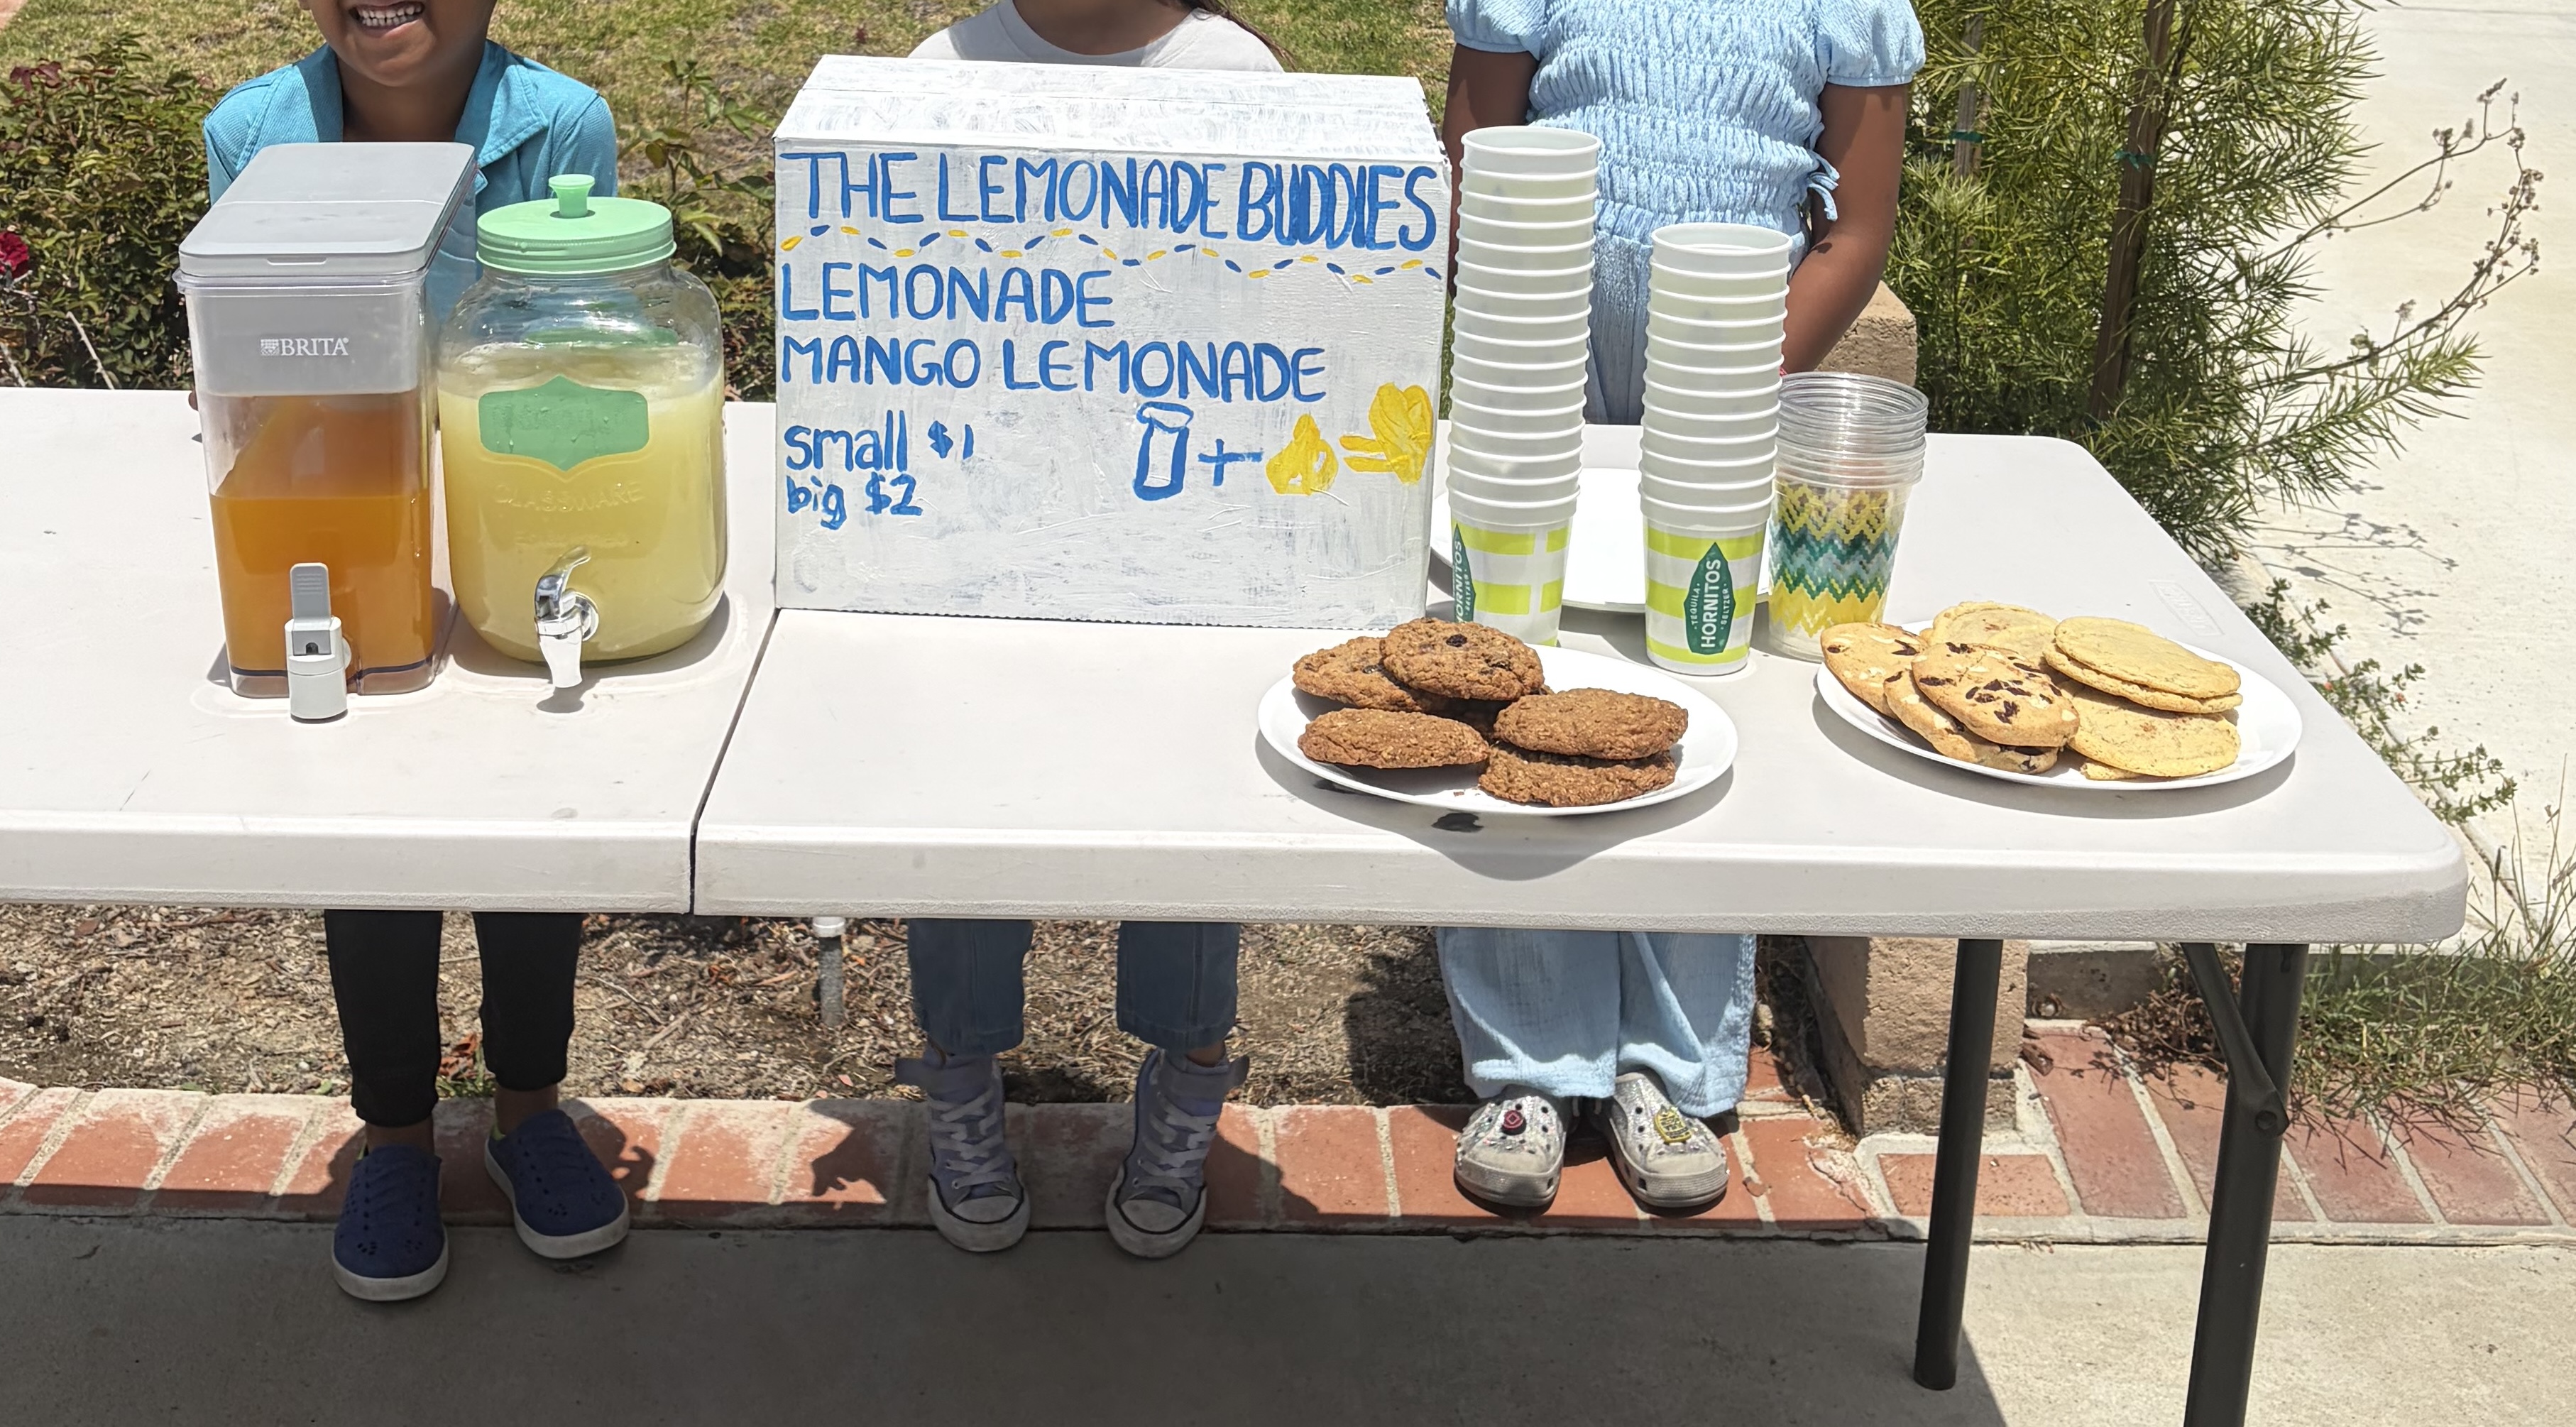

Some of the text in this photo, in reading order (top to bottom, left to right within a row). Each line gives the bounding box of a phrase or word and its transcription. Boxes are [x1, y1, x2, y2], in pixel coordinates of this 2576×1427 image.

[780, 151, 1437, 251] THE LEMONADE BUDDIES
[781, 262, 1115, 329] LEMONADE
[280, 338, 349, 356] BRITA
[782, 335, 1326, 403] MANGO LEMONADE
[783, 410, 975, 472] small $1
[786, 471, 922, 531] big $2
[1689, 587, 1701, 625] TEQUILA
[1701, 559, 1721, 647] HORNITOS
[1721, 588, 1731, 625] SELTZER
